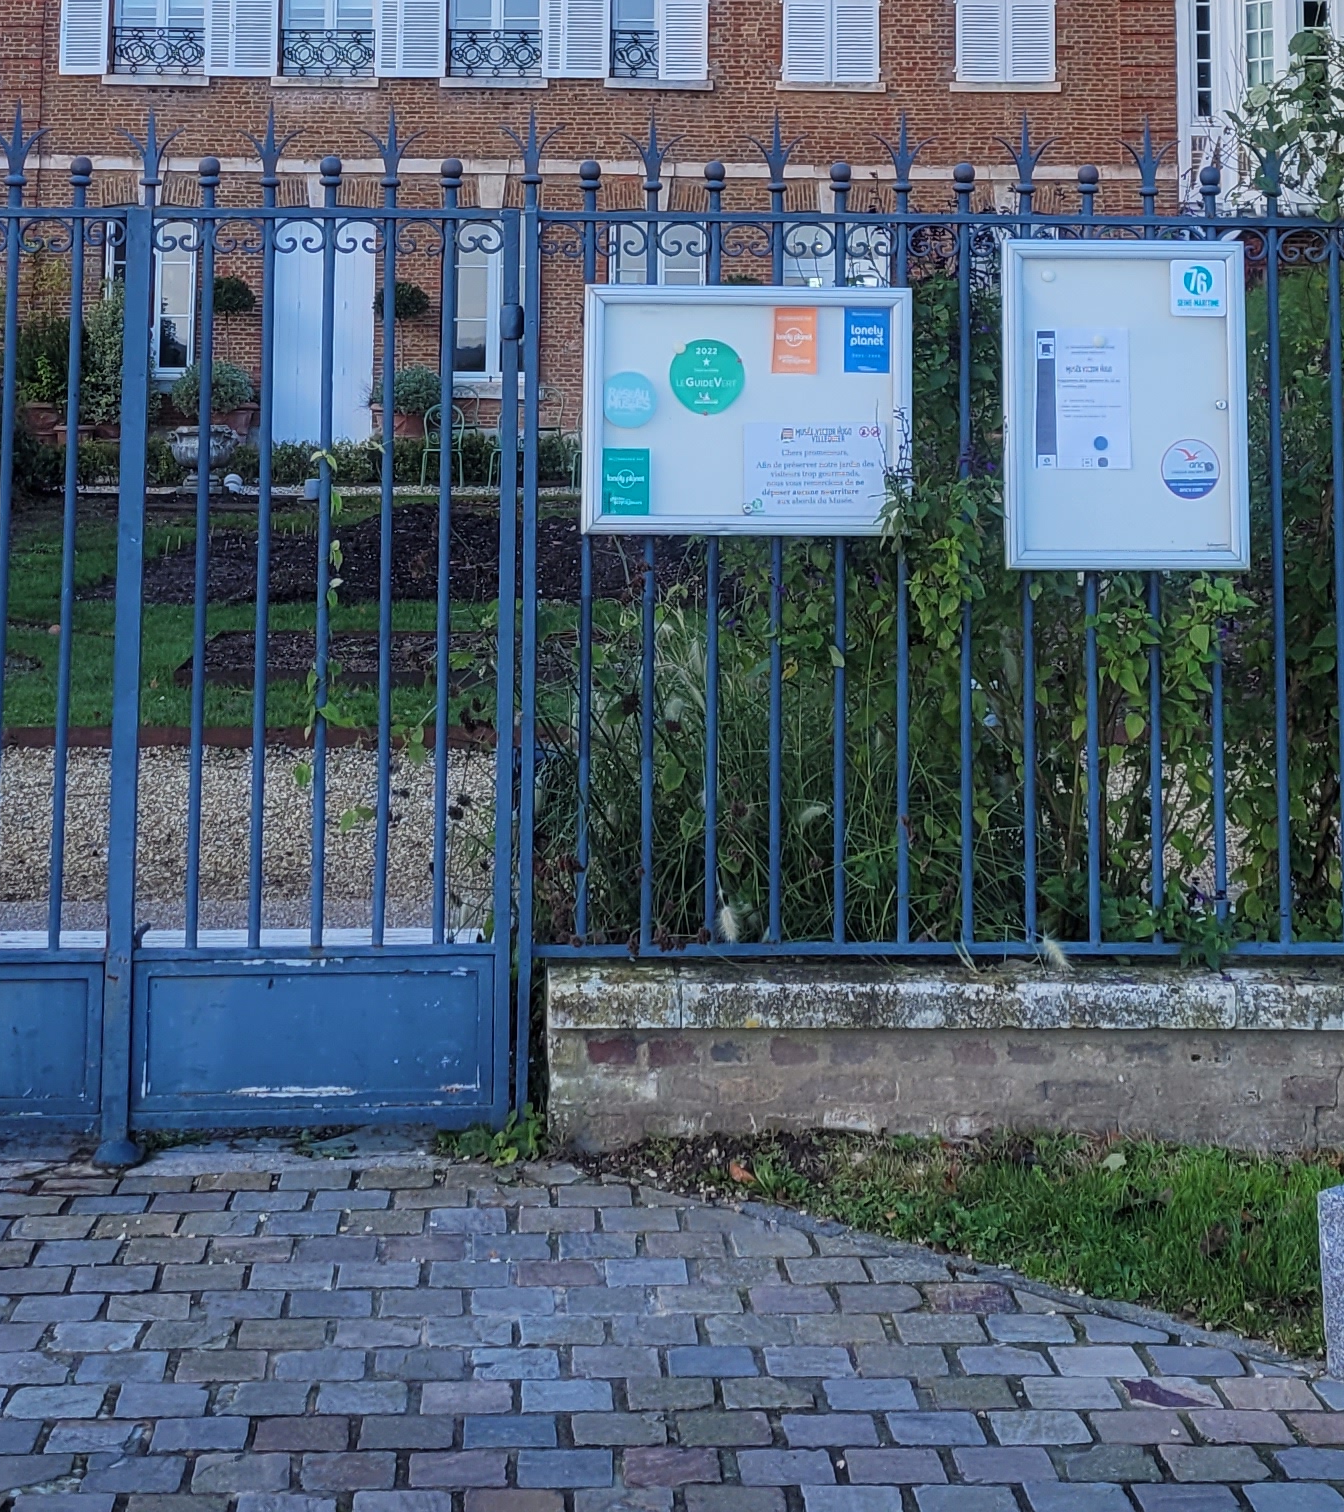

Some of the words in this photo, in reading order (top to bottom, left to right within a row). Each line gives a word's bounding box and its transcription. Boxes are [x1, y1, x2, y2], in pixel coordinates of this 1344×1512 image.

[1185, 268, 1208, 295] 76
[850, 325, 884, 338] lonely
[849, 336, 884, 346] planet
[695, 347, 718, 355] 2022
